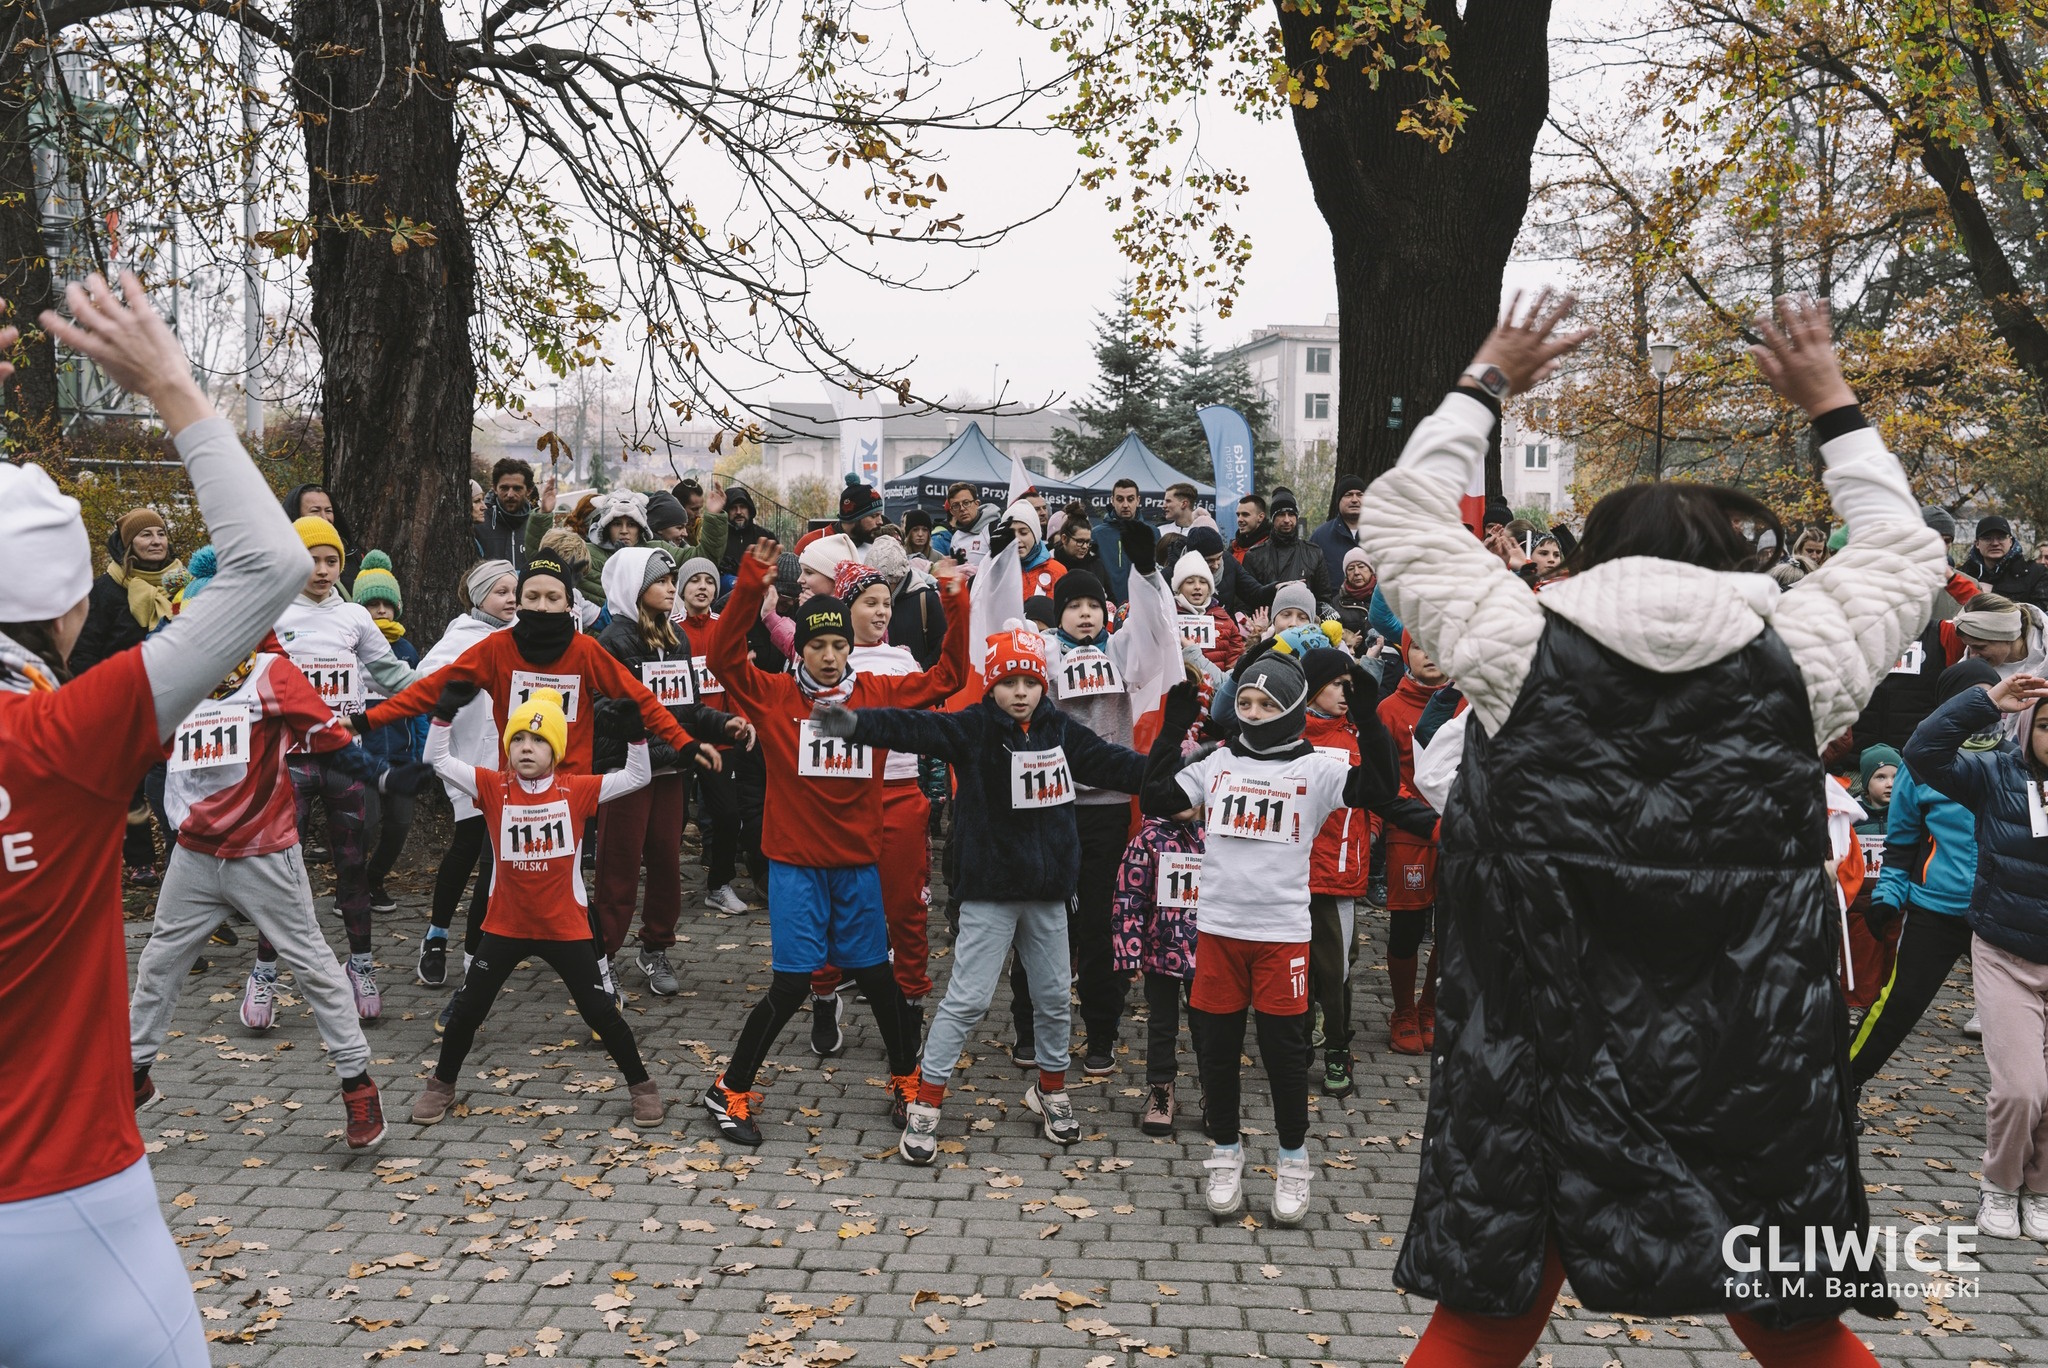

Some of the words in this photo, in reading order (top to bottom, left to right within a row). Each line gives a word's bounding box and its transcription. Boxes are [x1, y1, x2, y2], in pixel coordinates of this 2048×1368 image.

[1045, 492, 1067, 505] jest
[529, 560, 561, 572] TEAM
[806, 612, 842, 626] TEAM
[1006, 659, 1048, 680] POLS
[1267, 789, 1292, 799] Patrioty
[2, 831, 39, 873] E
[512, 861, 549, 872] POLSKA
[1290, 973, 1306, 999] 10
